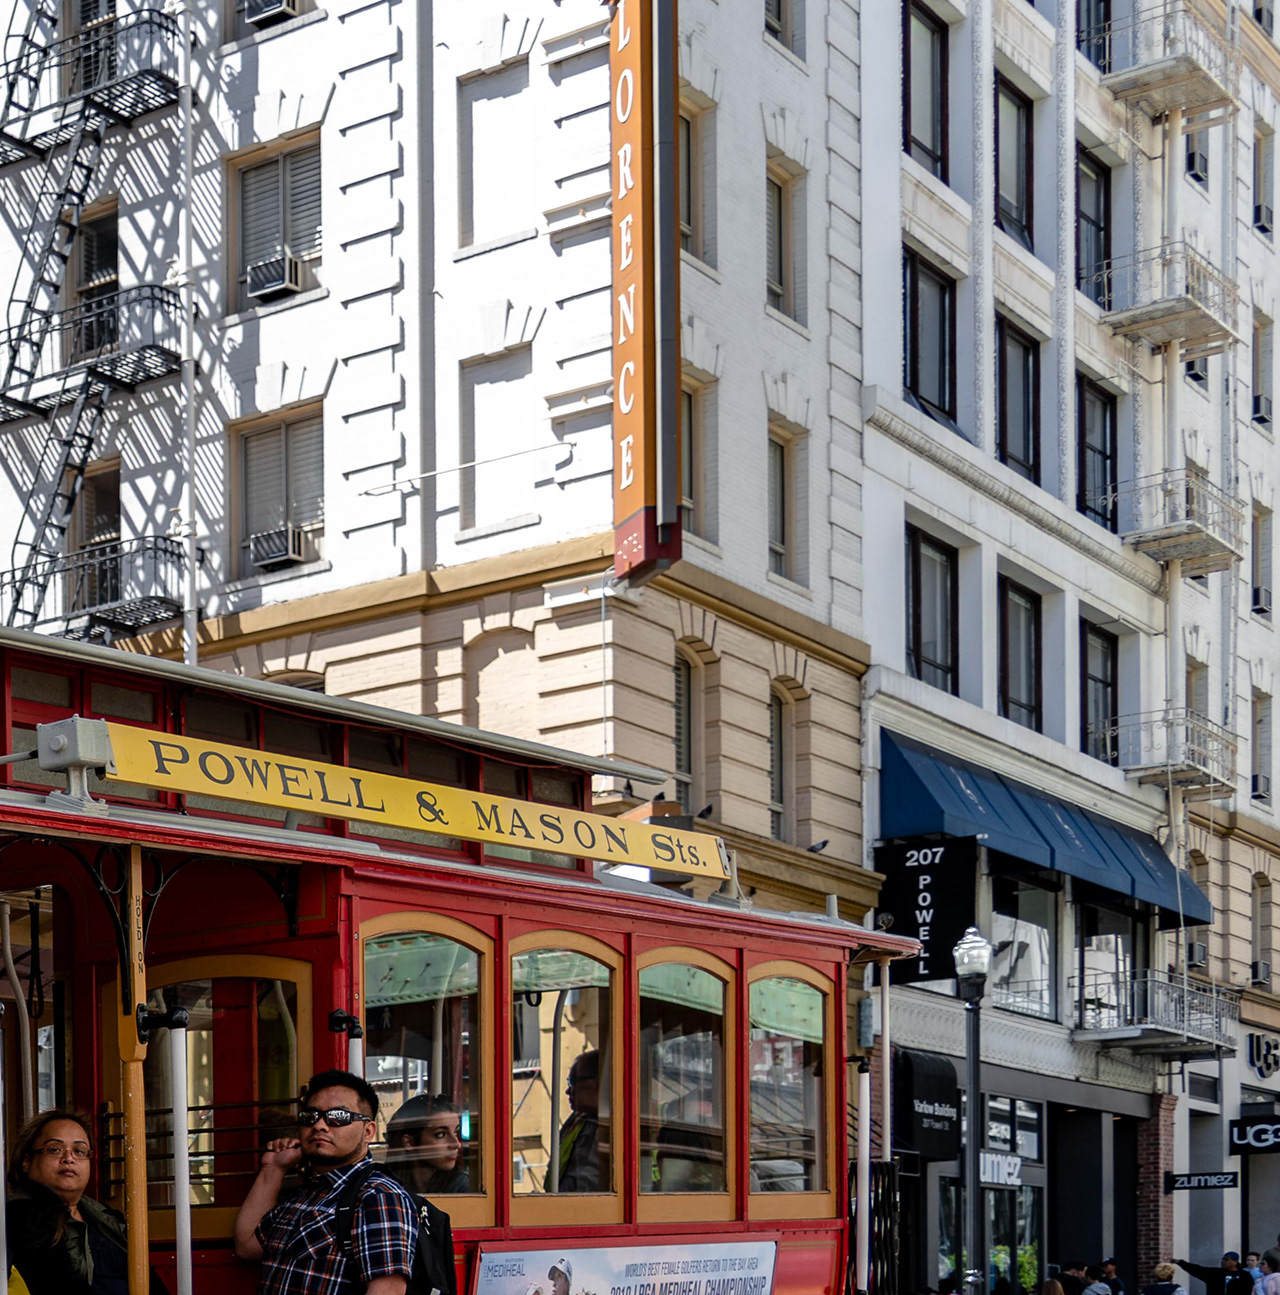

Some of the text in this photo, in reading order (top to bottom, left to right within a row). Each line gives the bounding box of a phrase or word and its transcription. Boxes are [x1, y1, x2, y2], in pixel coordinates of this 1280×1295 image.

[147, 739, 708, 868] POWELL & MASON Sts.
[905, 847, 945, 867] 207
[138, 951, 144, 974] ON
[1174, 1174, 1234, 1188] zumiez
[486, 1263, 525, 1278] MEDIHEAL
[624, 1256, 759, 1277] WORLD'S BEST FEMALE GOLFERS RETURN TO THE BAY AREA
